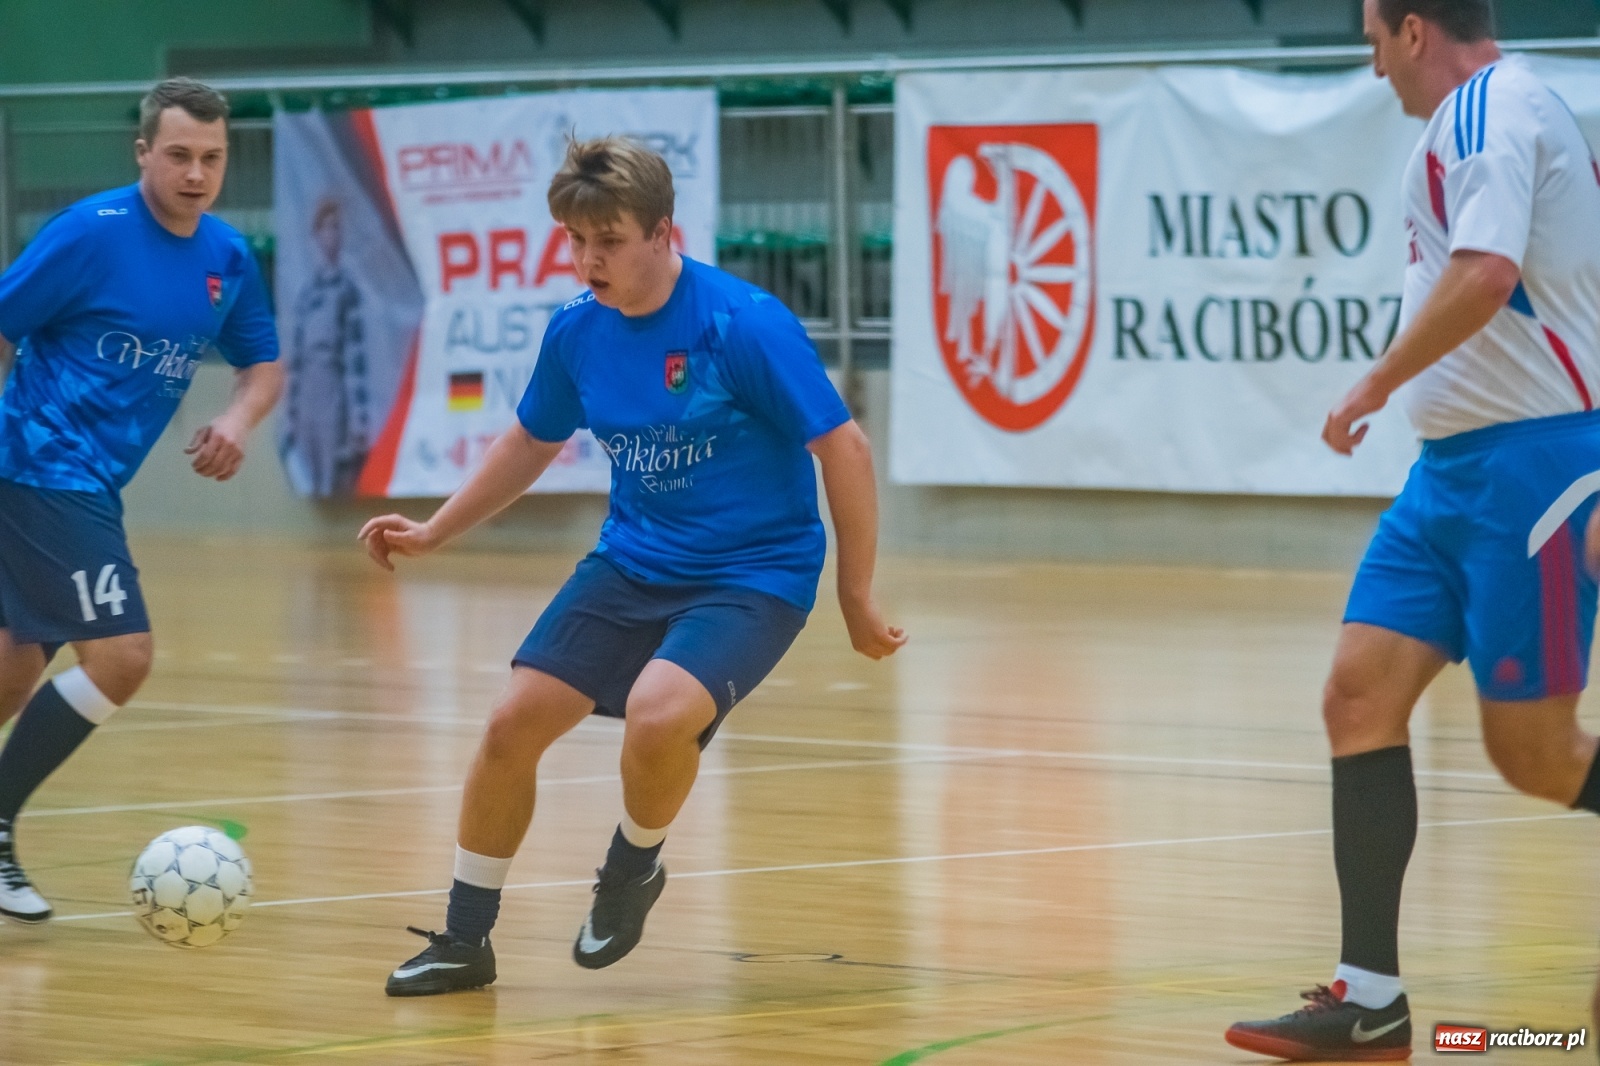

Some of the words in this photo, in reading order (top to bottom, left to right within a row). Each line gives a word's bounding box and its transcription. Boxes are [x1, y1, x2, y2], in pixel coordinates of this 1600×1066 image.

[397, 140, 533, 182] PRIMA
[1147, 188, 1372, 260] MIASTO
[437, 222, 686, 295] PRA
[597, 433, 718, 473] Viktoria
[70, 564, 128, 622] 14
